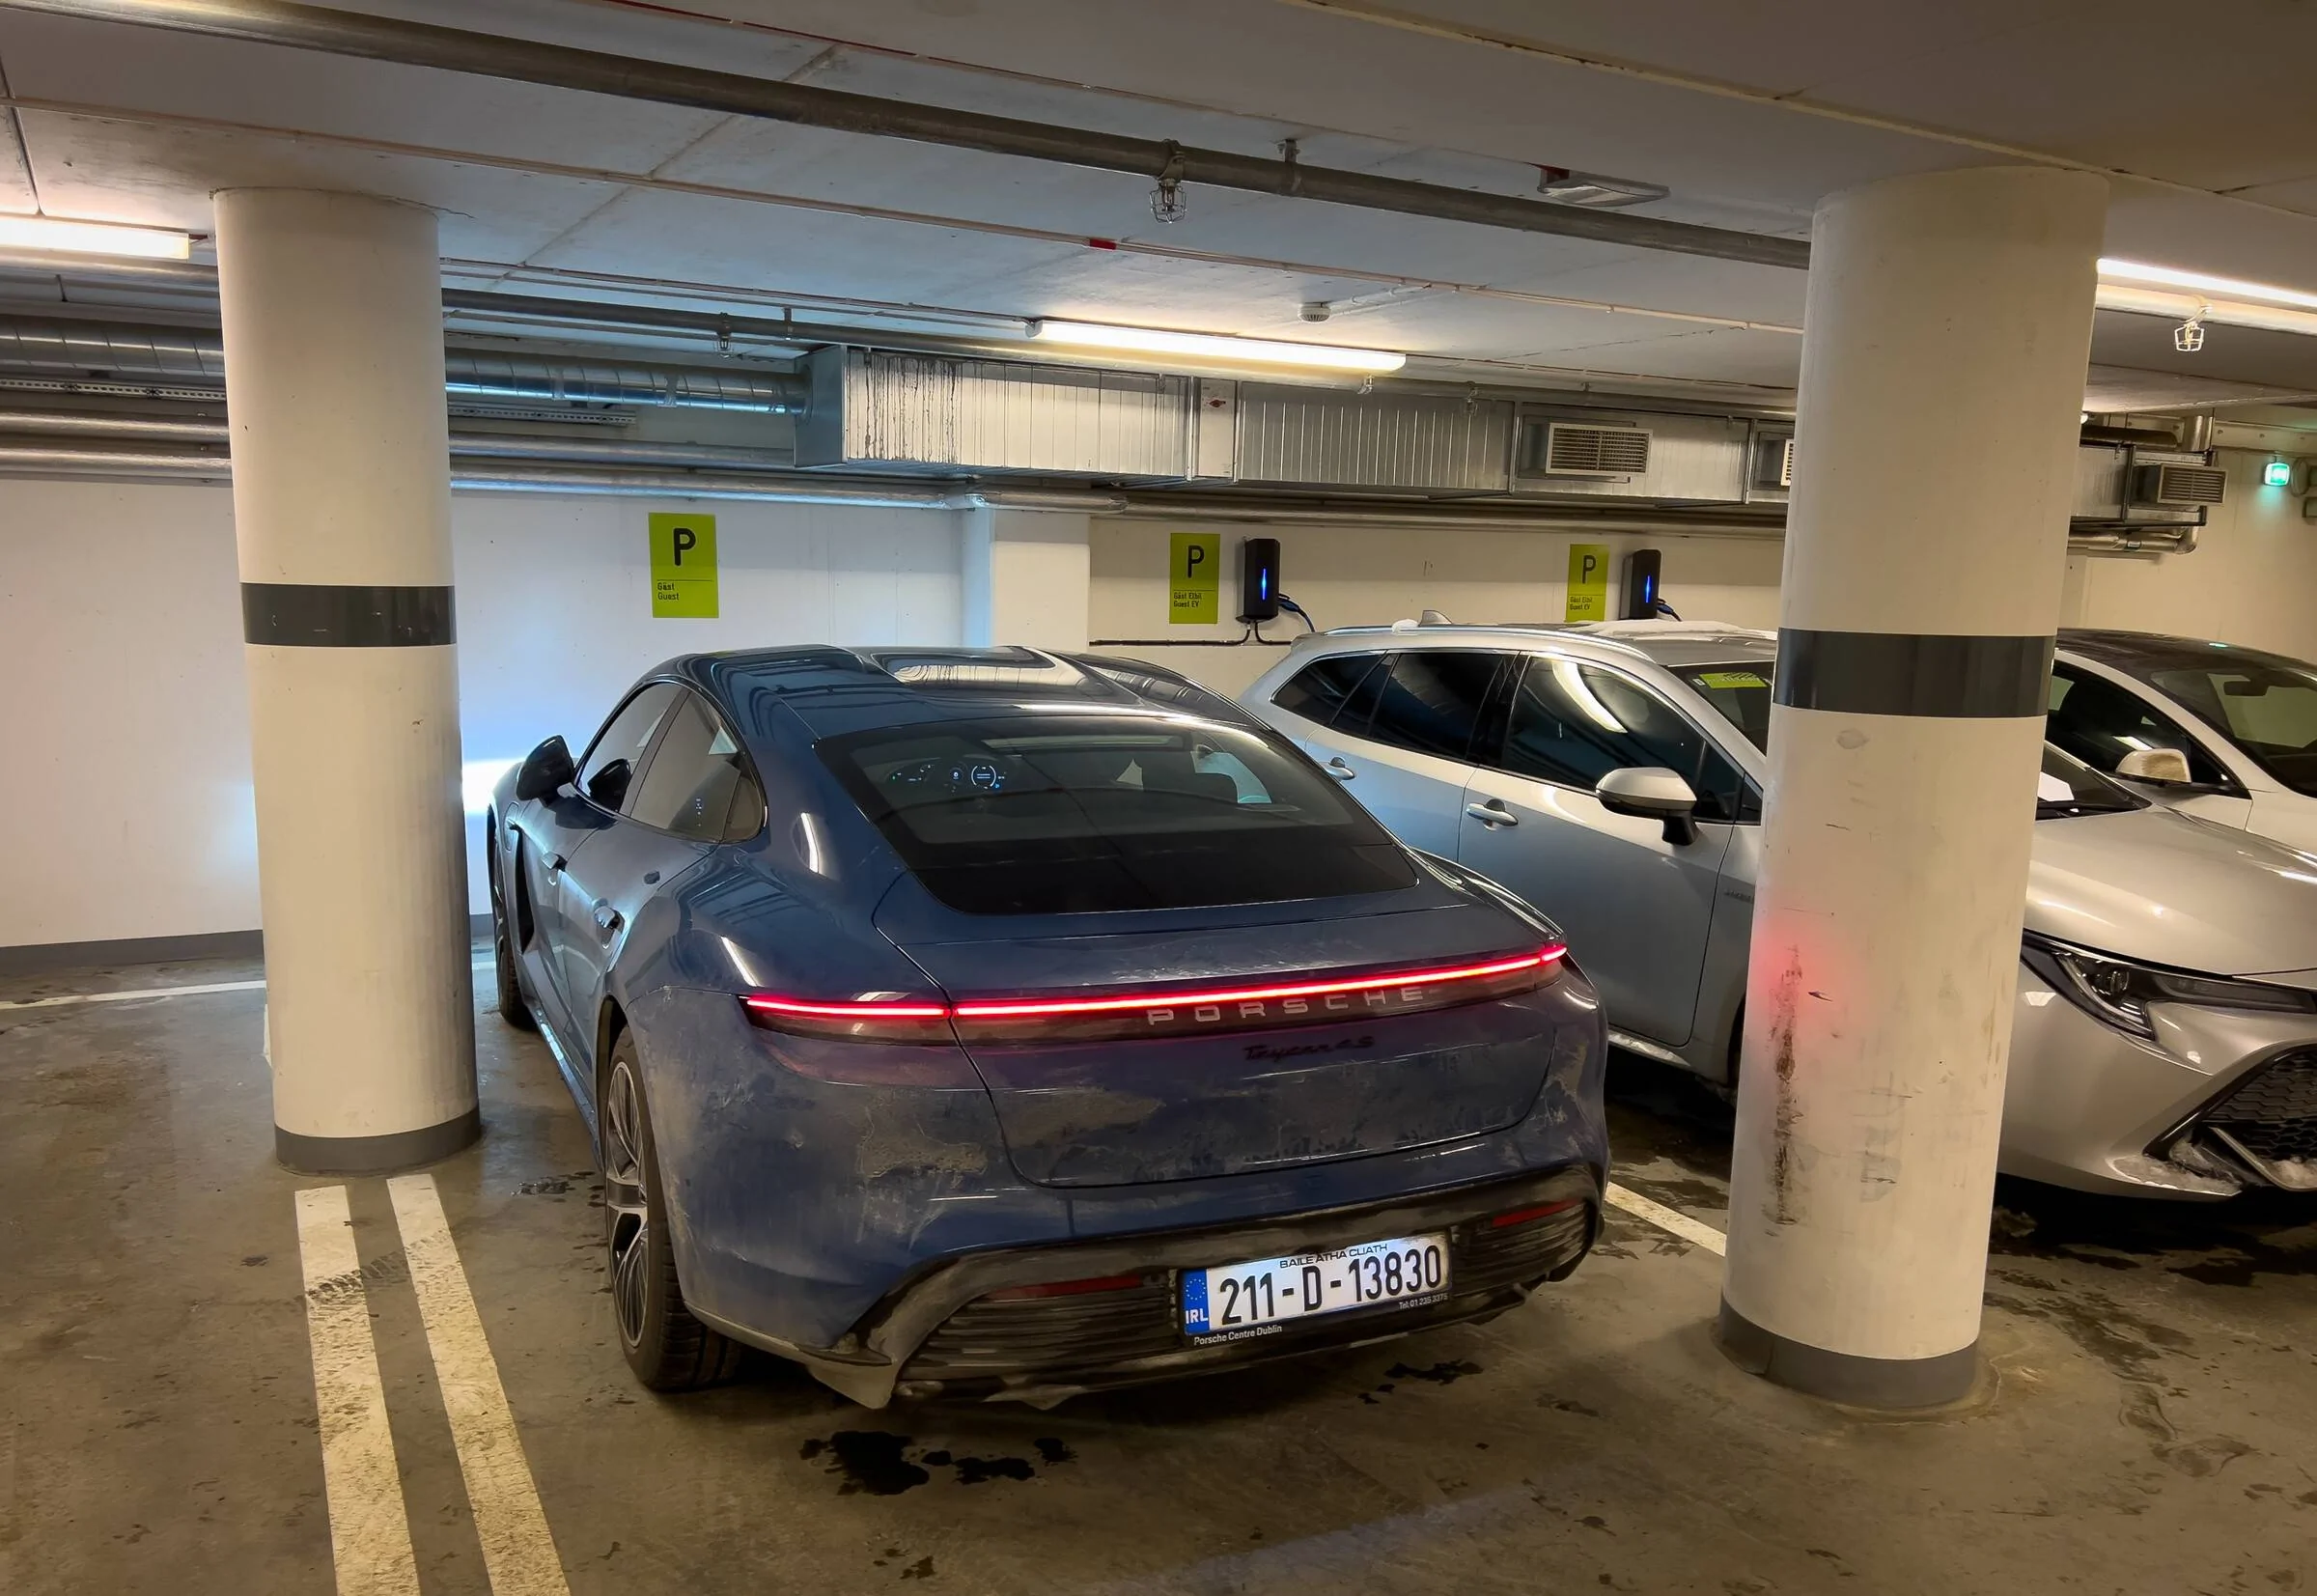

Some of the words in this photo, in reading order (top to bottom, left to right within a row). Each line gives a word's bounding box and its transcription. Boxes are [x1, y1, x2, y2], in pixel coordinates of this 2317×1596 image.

[673, 527, 696, 566] P
[1187, 545, 1205, 578] P
[1582, 554, 1596, 584] P
[657, 582, 675, 591] Gäst
[657, 592, 680, 601] Guest
[1147, 986, 1424, 1025] PORSCHE
[1279, 1254, 1314, 1269] BAILE
[1349, 1244, 1387, 1257] CLIATH
[1220, 1245, 1440, 1325] 211-D-13830
[1410, 1299, 1418, 1307] 01
[1186, 1308, 1208, 1324] IRL
[1193, 1333, 1227, 1346] Porsche
[1228, 1330, 1255, 1341] Centre
[1256, 1325, 1283, 1336] Dublin
